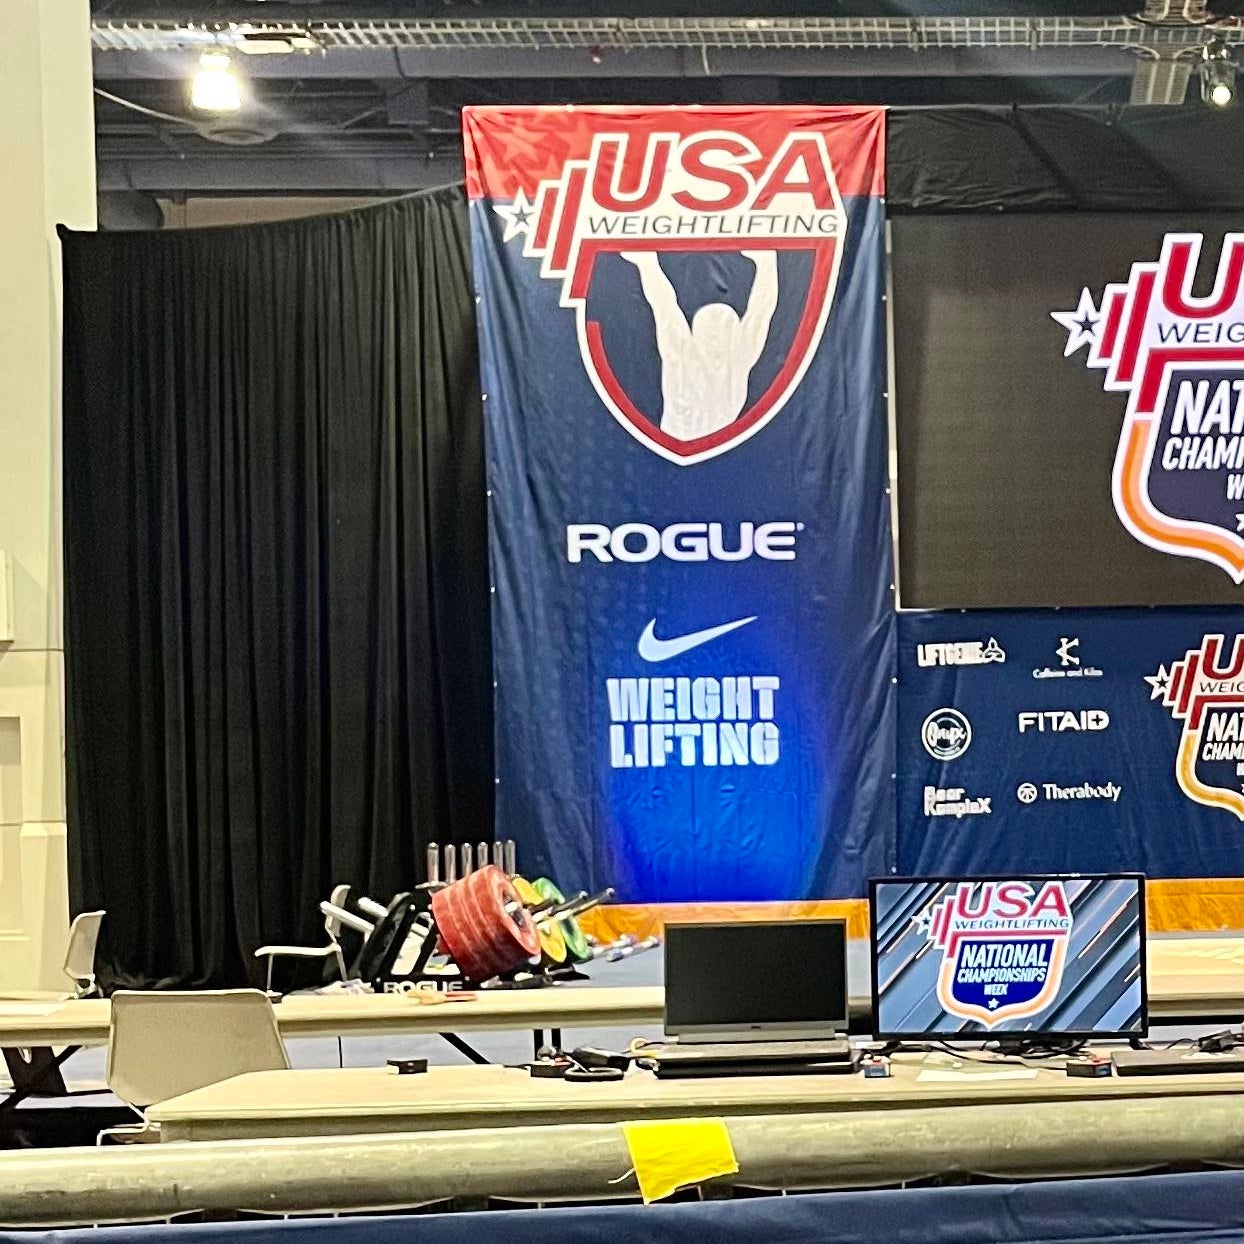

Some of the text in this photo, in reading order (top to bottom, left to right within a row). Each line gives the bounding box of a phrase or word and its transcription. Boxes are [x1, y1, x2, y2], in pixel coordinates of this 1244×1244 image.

[590, 136, 837, 212] USA
[588, 213, 838, 235] WEIGHTLIFTING
[566, 521, 797, 564] ROGUE
[606, 676, 780, 722] WEIGHT
[1018, 709, 1110, 733] FITAID
[609, 722, 780, 769] LIFTING
[1042, 782, 1122, 802] Therabody
[956, 884, 1070, 919] USA
[954, 918, 1070, 930] WEIGHTLIFTING
[960, 943, 1049, 968] NATIONAL
[957, 967, 1048, 983] CHAMPIONSHIPS
[983, 983, 1008, 996] WEEK
